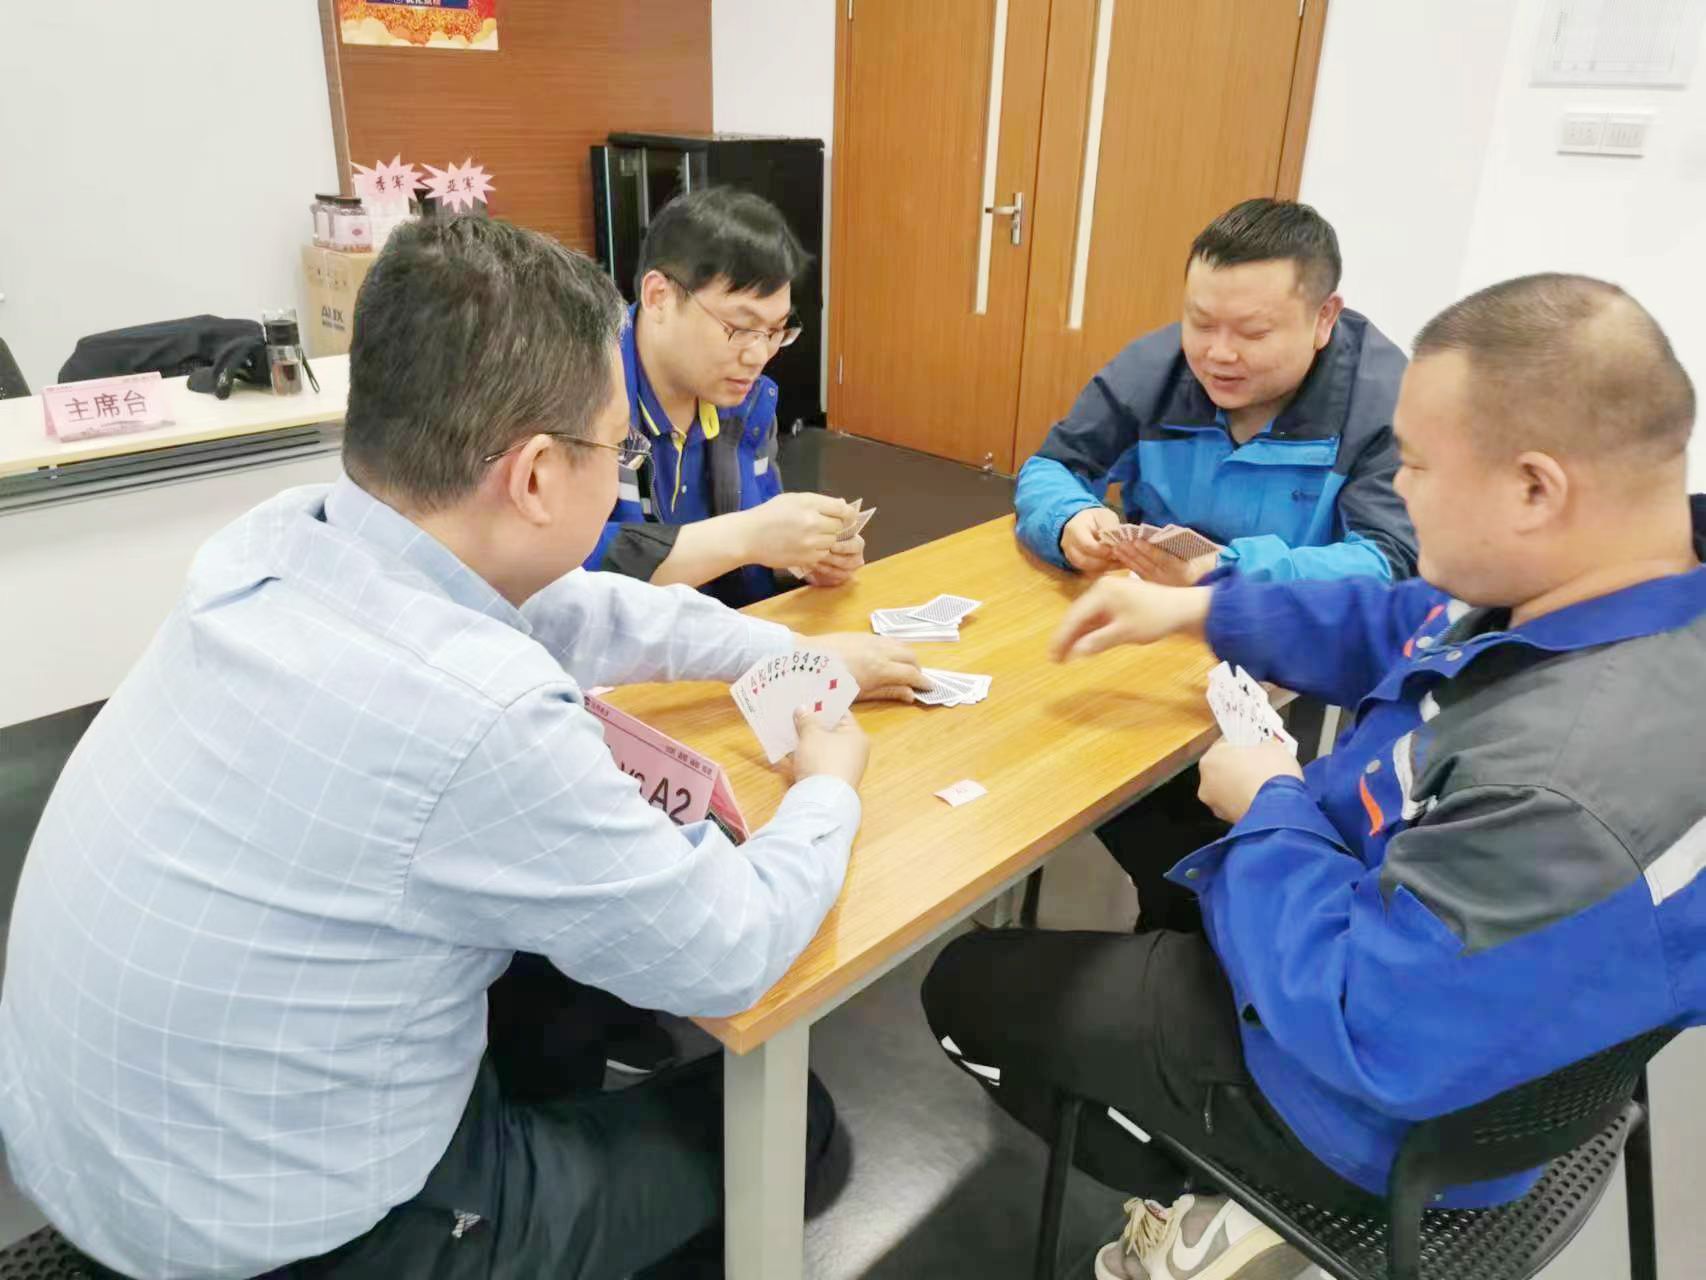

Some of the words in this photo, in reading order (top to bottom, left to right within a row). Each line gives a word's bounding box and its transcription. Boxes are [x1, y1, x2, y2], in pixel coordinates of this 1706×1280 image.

[446, 175, 474, 193] 亚军
[64, 390, 147, 422] 主席台
[792, 651, 800, 663] 6
[802, 652, 810, 663] 4
[813, 655, 820, 665] 4
[648, 777, 692, 826] A2
